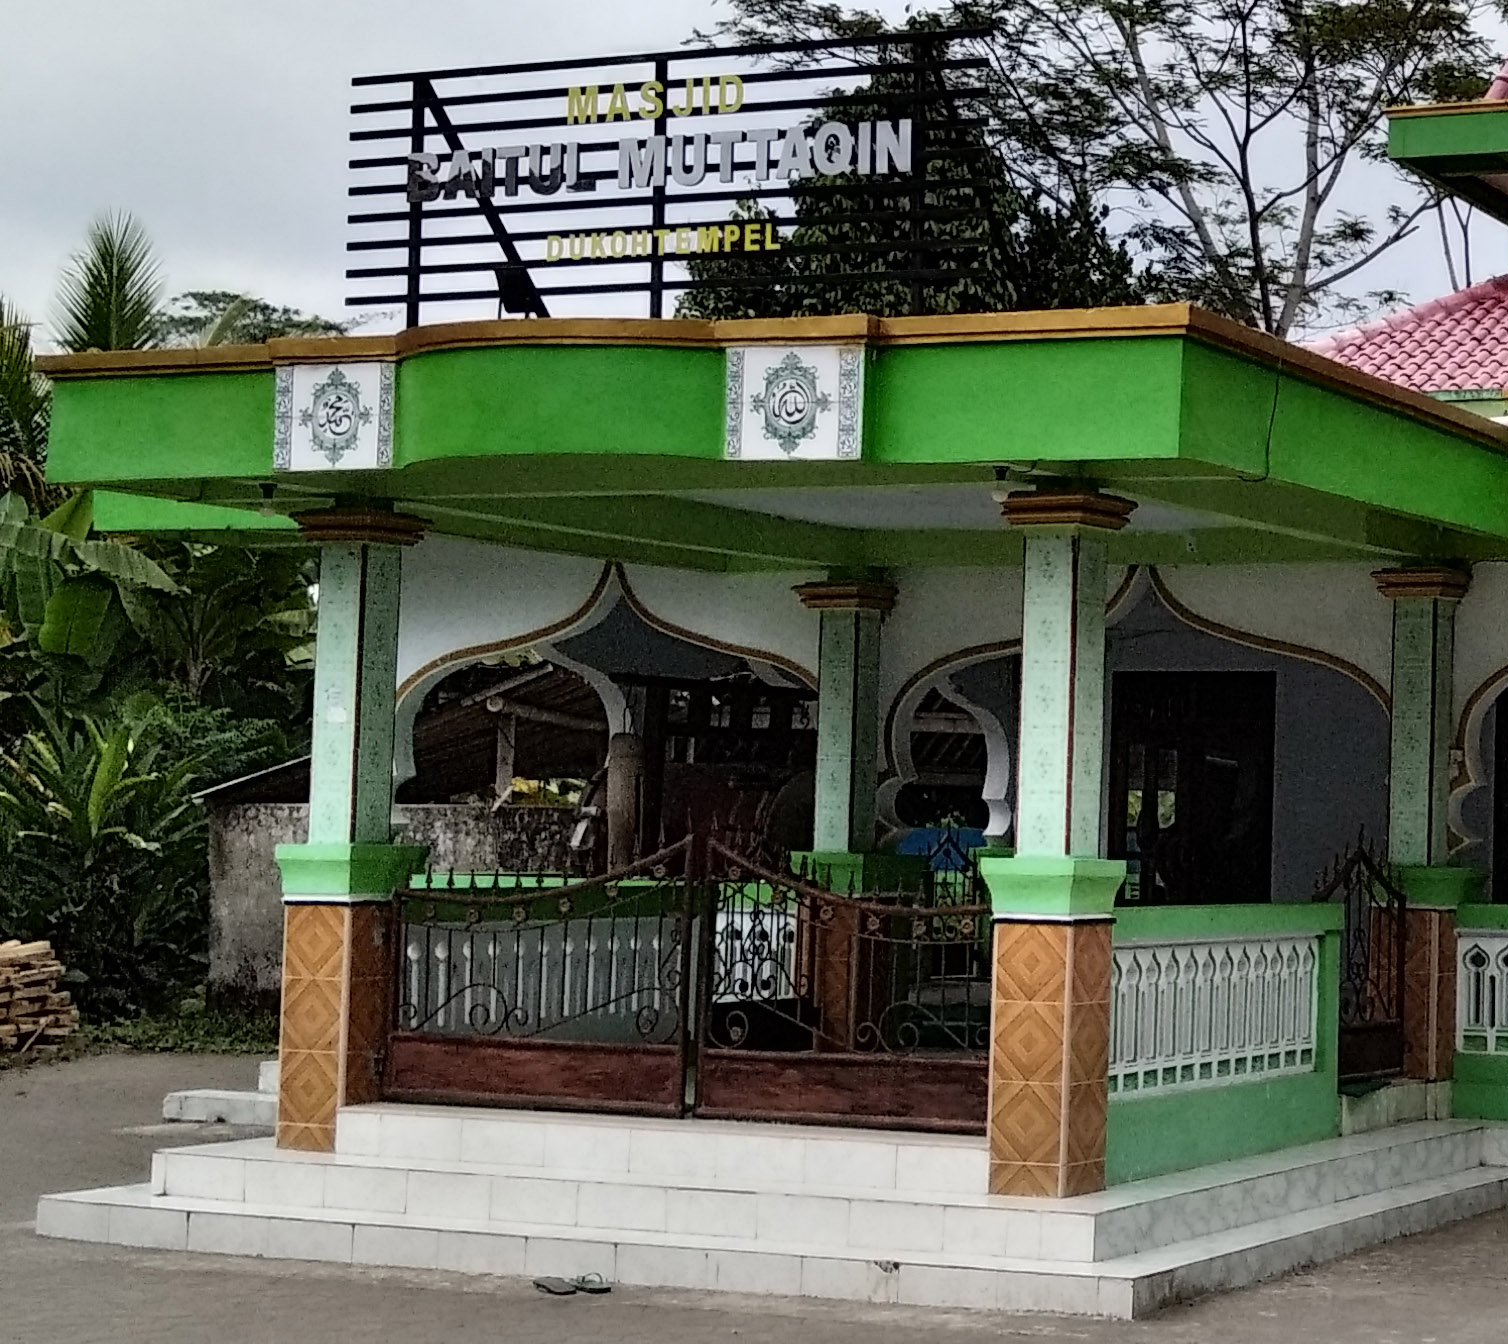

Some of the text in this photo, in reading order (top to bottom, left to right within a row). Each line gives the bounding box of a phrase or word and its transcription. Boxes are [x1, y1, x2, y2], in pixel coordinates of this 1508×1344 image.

[567, 74, 745, 125] MASJID
[407, 119, 912, 203] BAITUL MUTTAQIN
